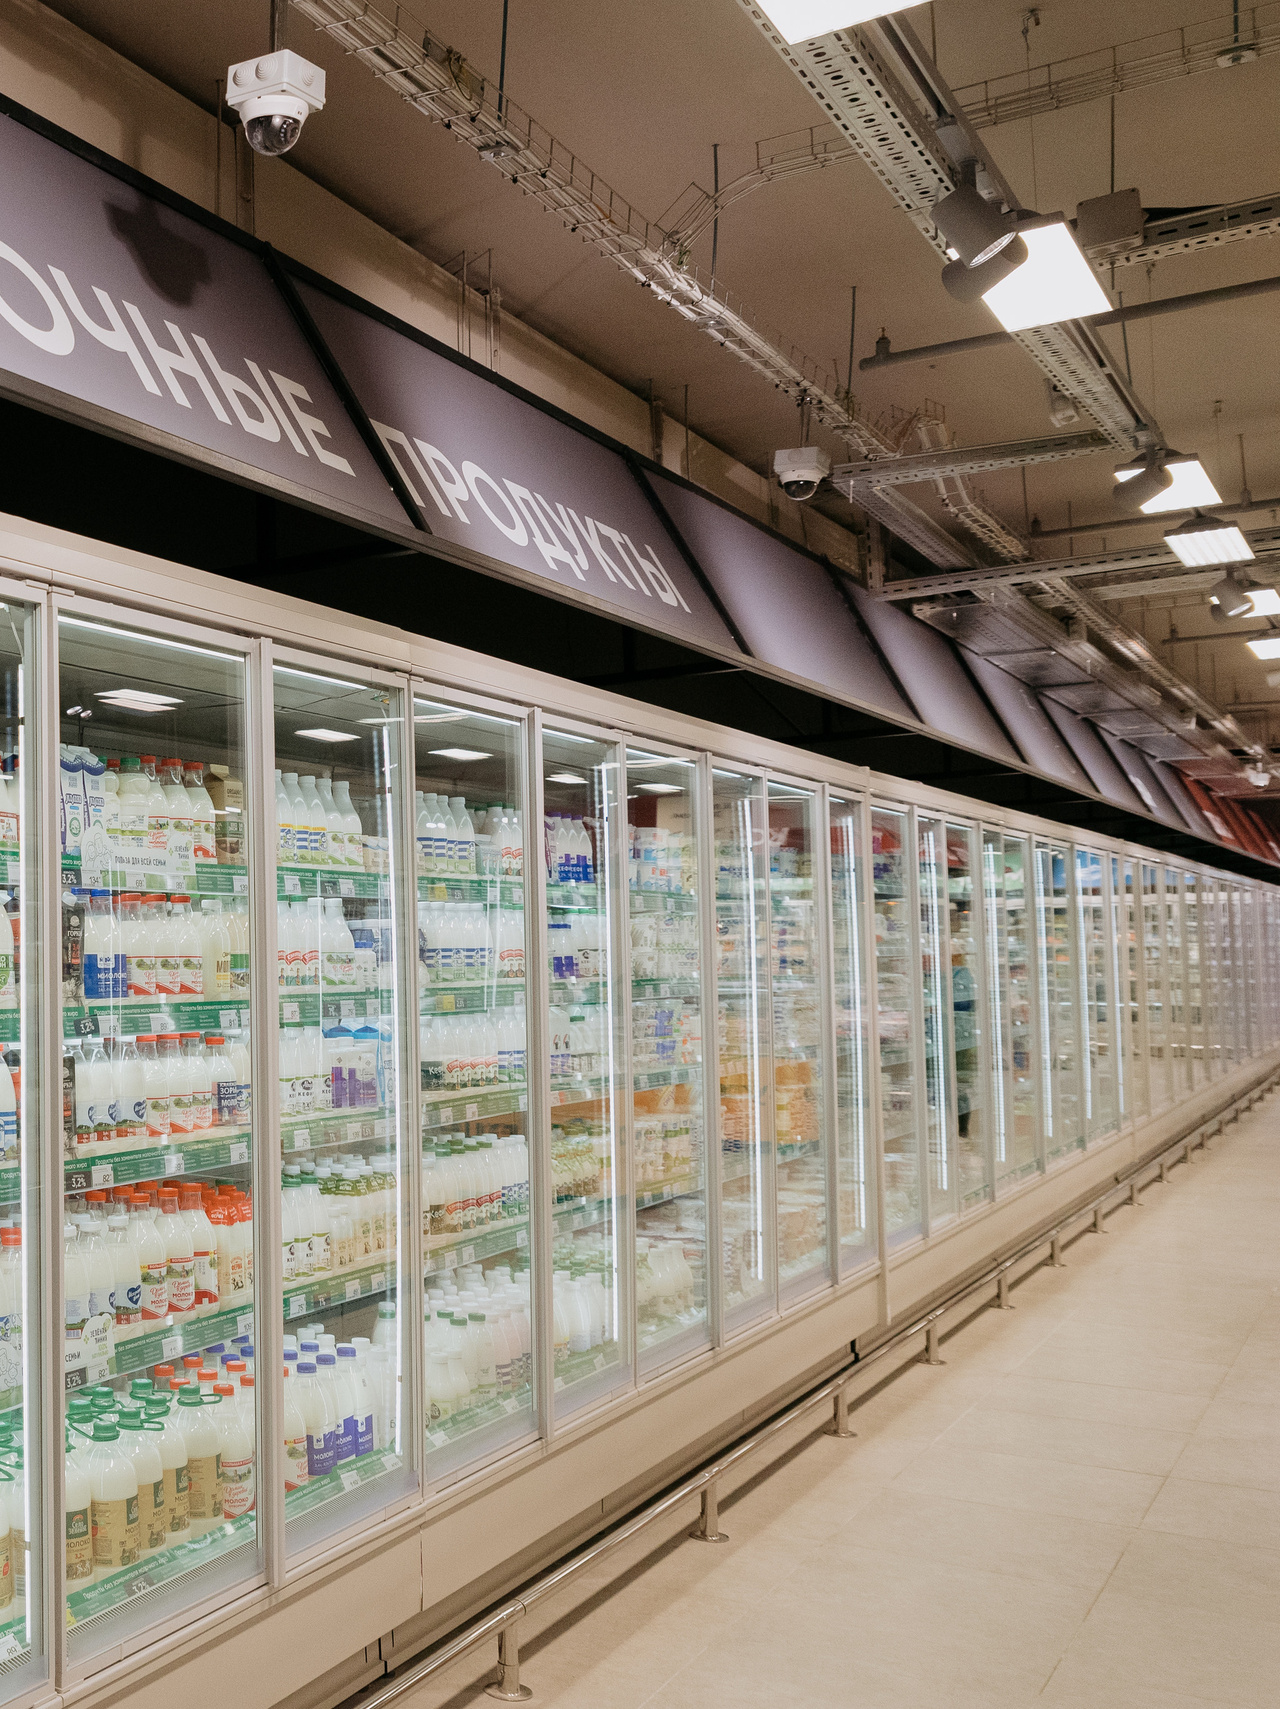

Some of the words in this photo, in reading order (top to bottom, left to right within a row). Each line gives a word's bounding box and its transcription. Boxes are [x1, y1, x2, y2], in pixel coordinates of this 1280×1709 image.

[369, 418, 692, 614] ПРОДУКТЫ
[141, 857, 152, 866] ВСЕЙ
[62, 873, 77, 884] 3,2%
[89, 876, 99, 884] 134
[80, 1022, 95, 1032] 3,2%
[71, 1178, 86, 1188] 3,2%
[103, 1174, 110, 1182] 82
[98, 1369, 106, 1378] 82
[66, 1375, 82, 1388] 3,2%
